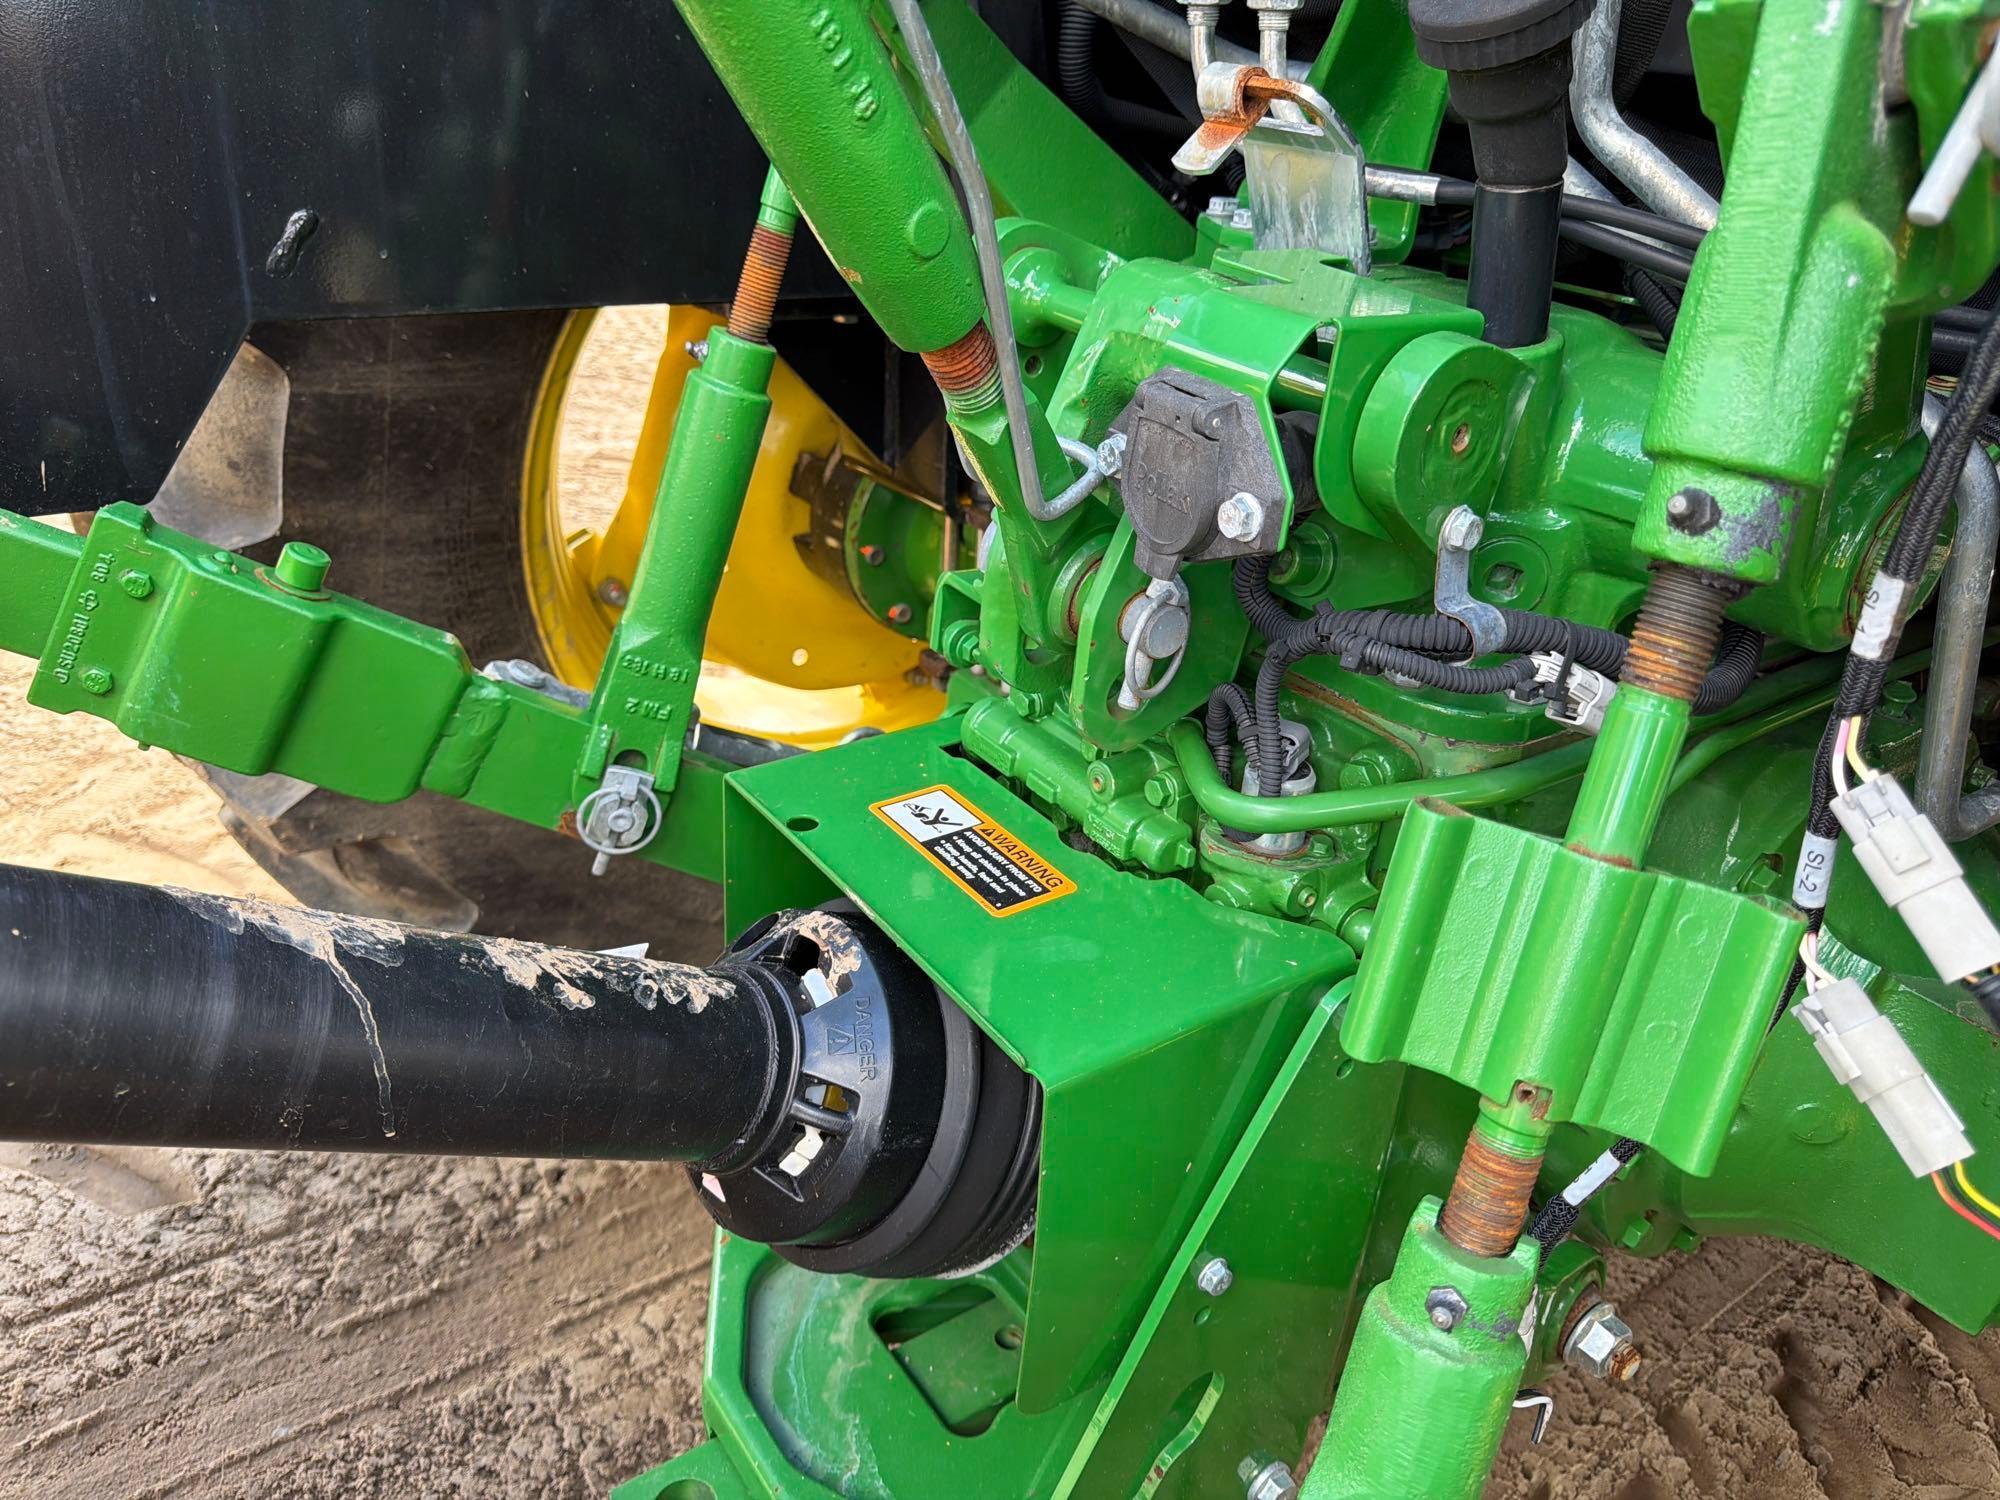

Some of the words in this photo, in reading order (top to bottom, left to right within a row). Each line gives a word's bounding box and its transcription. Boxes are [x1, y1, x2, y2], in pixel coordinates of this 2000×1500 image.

[933, 845, 960, 867] clothing
[956, 865, 976, 880] away
[942, 842, 960, 857] Keep
[977, 871, 994, 884] feet
[989, 882, 1007, 894] and
[955, 838, 973, 853] Keep
[970, 851, 983, 860] all
[977, 857, 1002, 877] shields
[999, 874, 1009, 883] in
[1004, 880, 1027, 897] place
[963, 831, 987, 847] AVOID
[982, 845, 1009, 865] INJURY
[1005, 861, 1029, 881] FROM
[1024, 879, 1042, 893] PTO
[993, 833, 1063, 888] WARNING
[1798, 850, 1825, 892] SL-2
[855, 996, 877, 1083] DANGER
